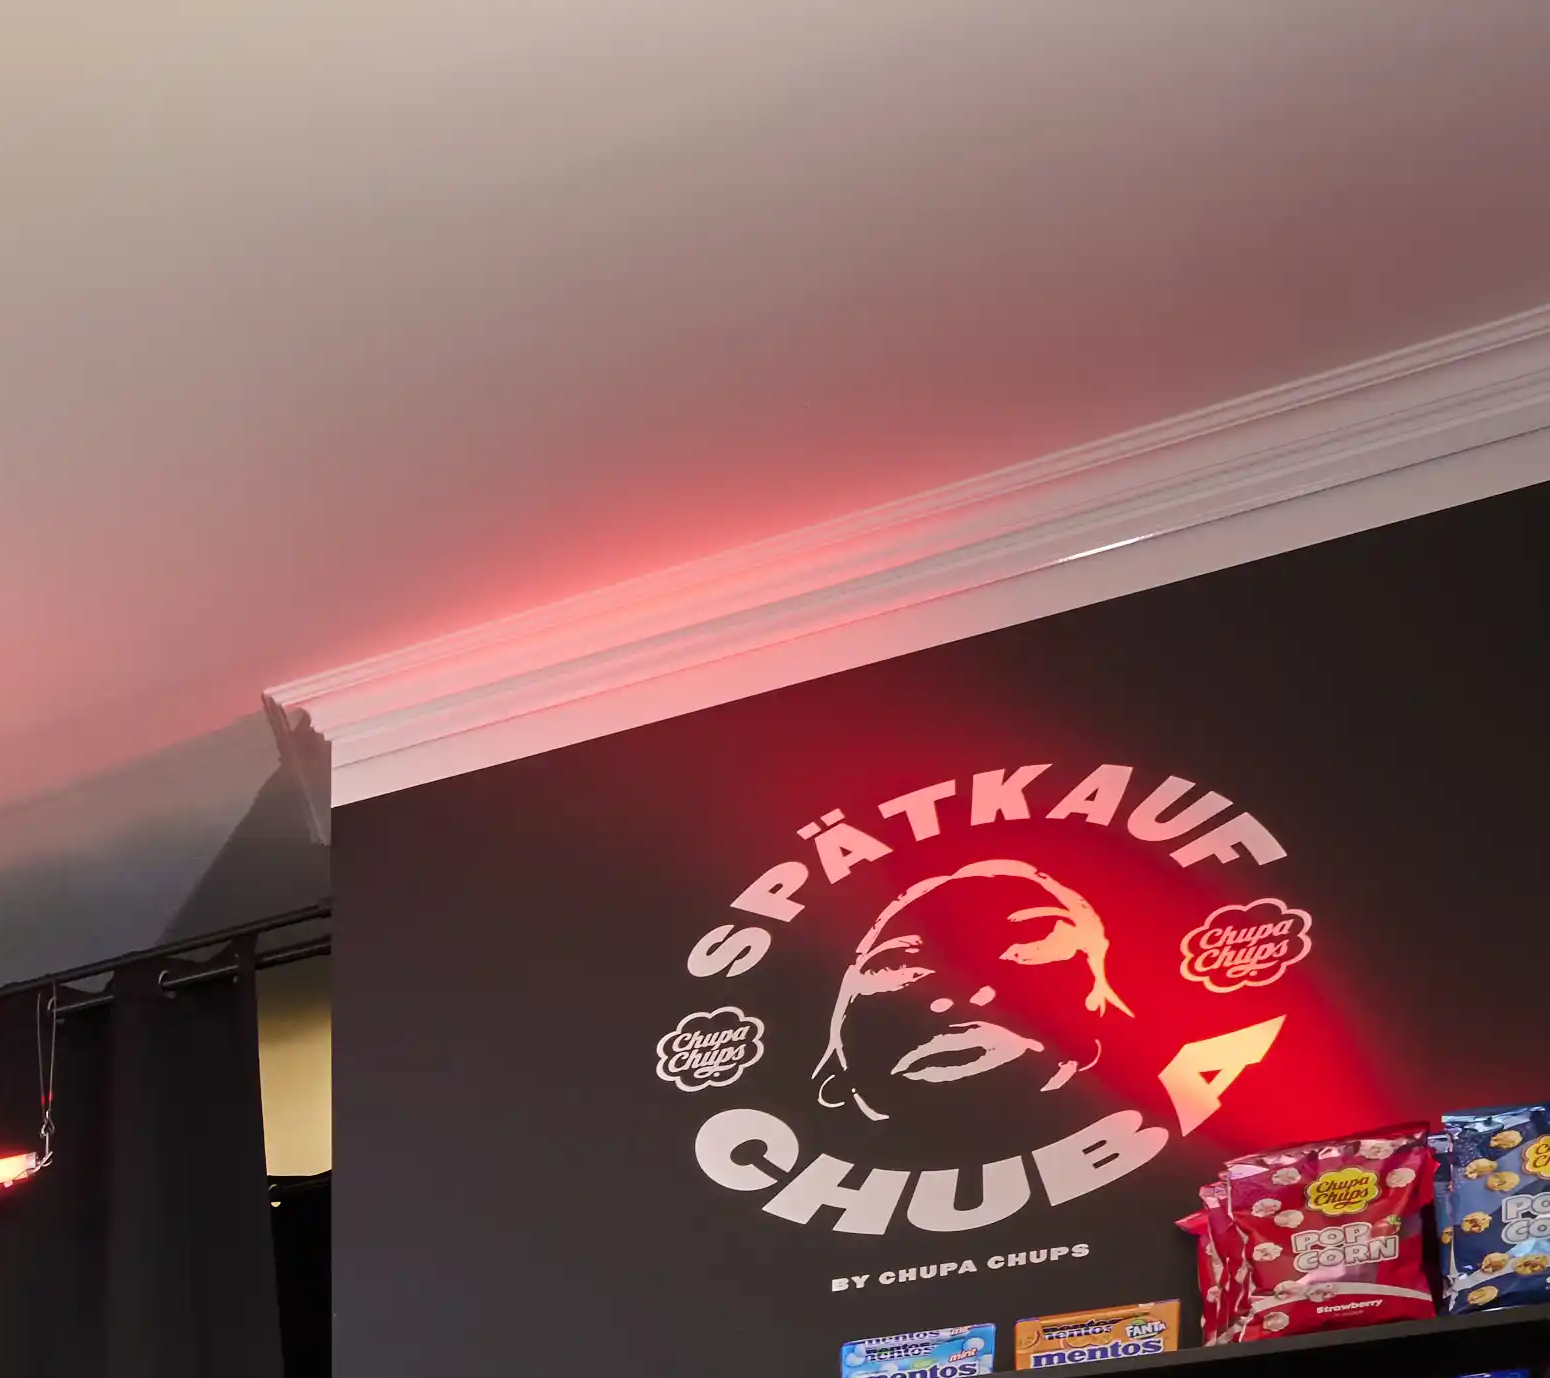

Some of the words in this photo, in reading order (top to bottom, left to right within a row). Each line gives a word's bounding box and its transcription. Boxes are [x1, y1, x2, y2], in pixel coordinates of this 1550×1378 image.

[687, 764, 1287, 978] SPÄTKAUF
[1199, 916, 1292, 951] Chupa
[1194, 937, 1287, 978] Chups
[674, 1025, 747, 1054] Chupa
[670, 1042, 744, 1076] Chups
[695, 1015, 1286, 1234] CHUBA
[1315, 1188, 1368, 1208] Chups
[1317, 1176, 1369, 1196] Chupa
[1502, 1193, 1550, 1222] PO
[1291, 1222, 1371, 1254] POP
[1293, 1236, 1399, 1272] CORN
[832, 1277, 870, 1292] BY
[878, 1259, 977, 1285] CHUPA
[987, 1244, 1089, 1270] CHUPS
[1126, 1318, 1165, 1338] FANTA
[1032, 1339, 1162, 1367] mentos
